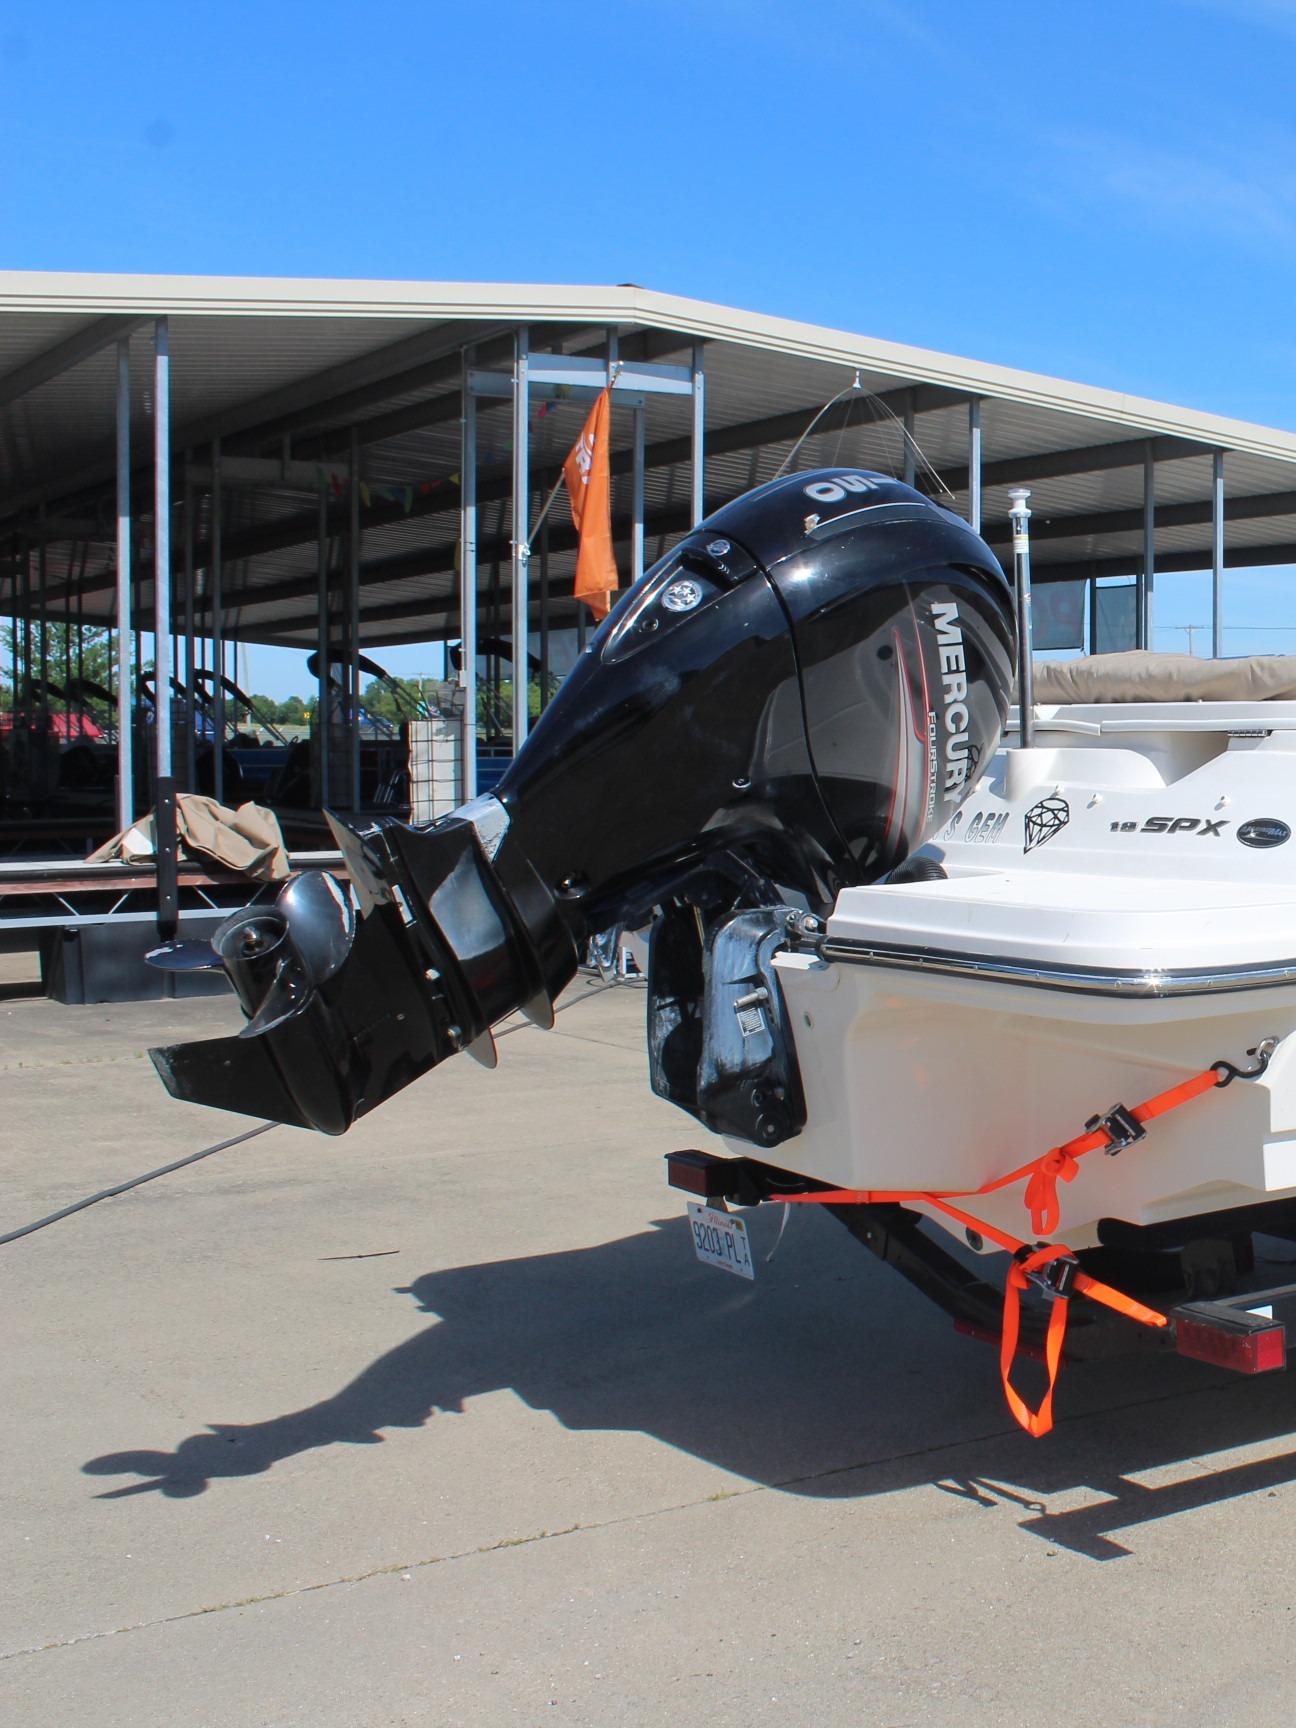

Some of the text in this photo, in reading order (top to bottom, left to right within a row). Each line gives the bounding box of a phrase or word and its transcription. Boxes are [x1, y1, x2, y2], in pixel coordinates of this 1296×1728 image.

[930, 602, 970, 803] MERCURY
[964, 811, 1010, 844] GEM
[1140, 816, 1231, 837] SPX
[692, 1220, 723, 1257] 9203
[724, 1231, 742, 1264] PL
